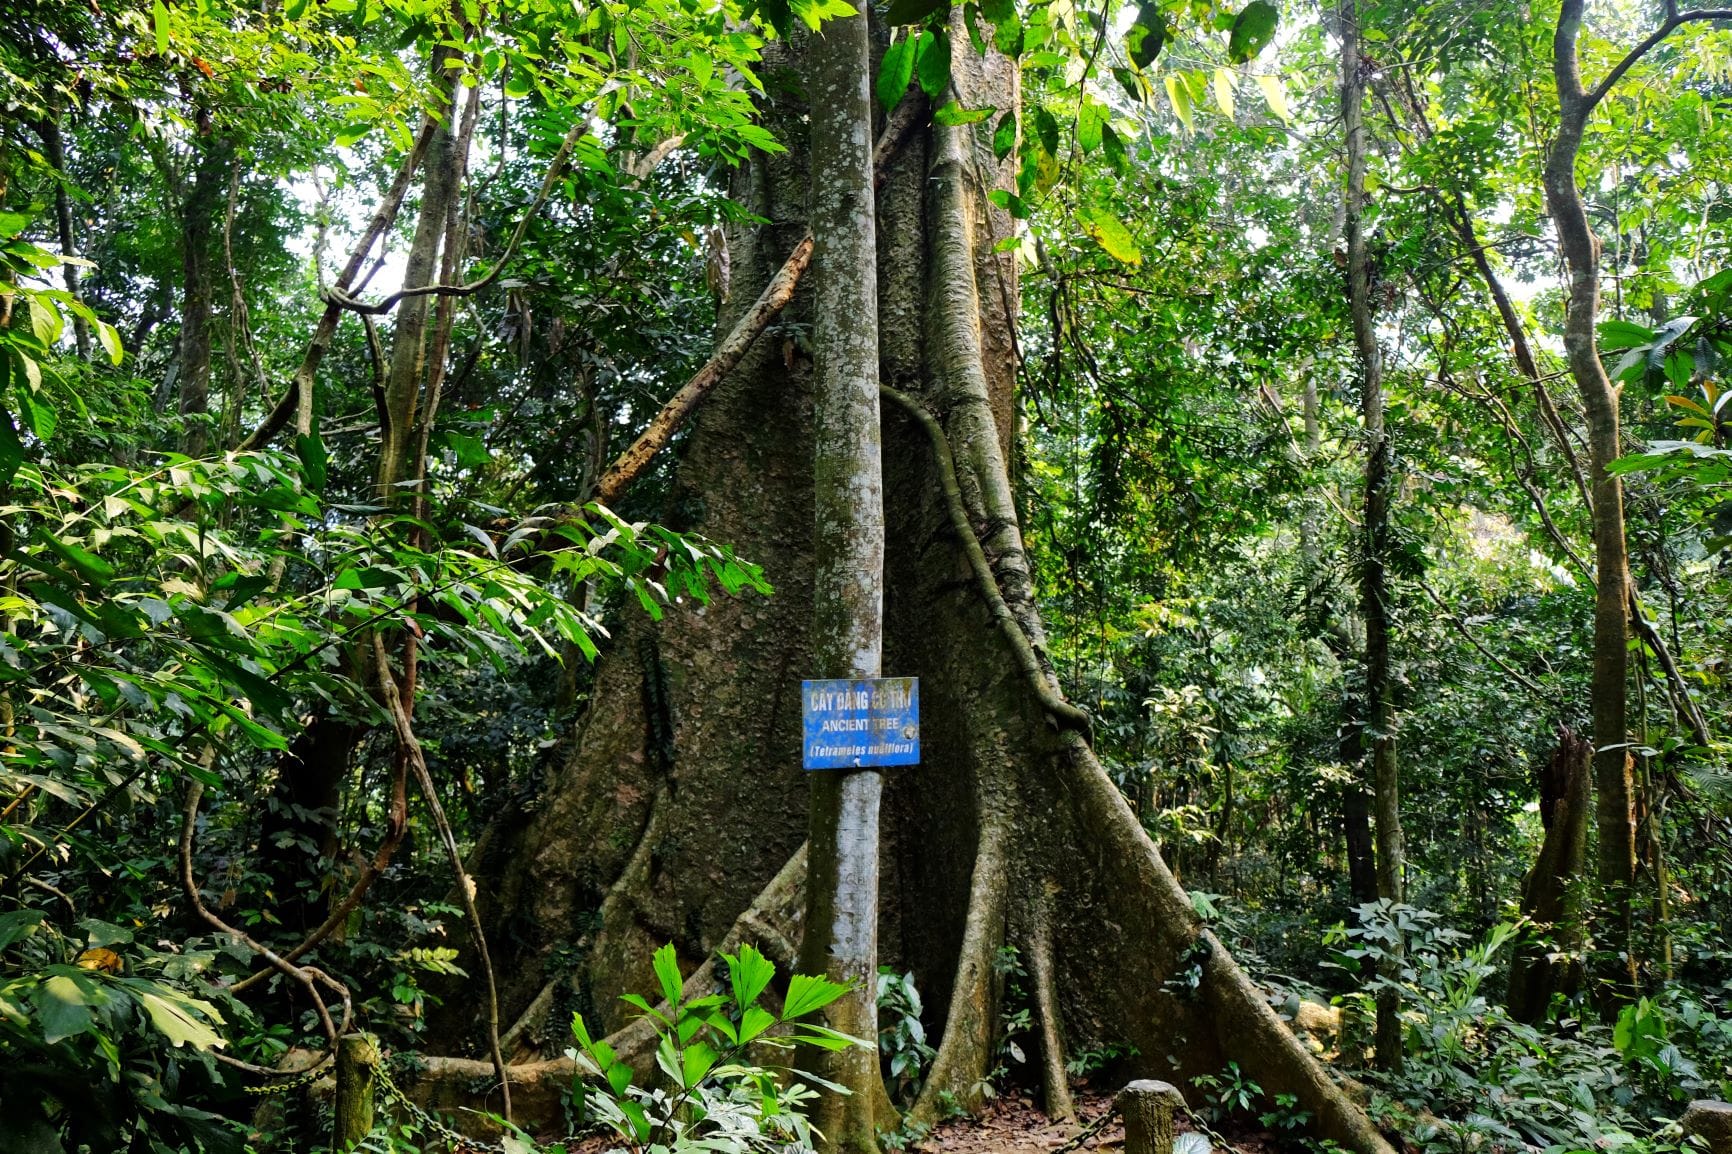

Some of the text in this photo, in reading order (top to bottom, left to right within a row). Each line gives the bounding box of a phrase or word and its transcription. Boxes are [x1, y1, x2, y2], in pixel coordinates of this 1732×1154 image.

[811, 688, 833, 711] CÂY
[822, 718, 899, 732] ANCIENT TREE
[810, 744, 866, 757] (Tetrameles
